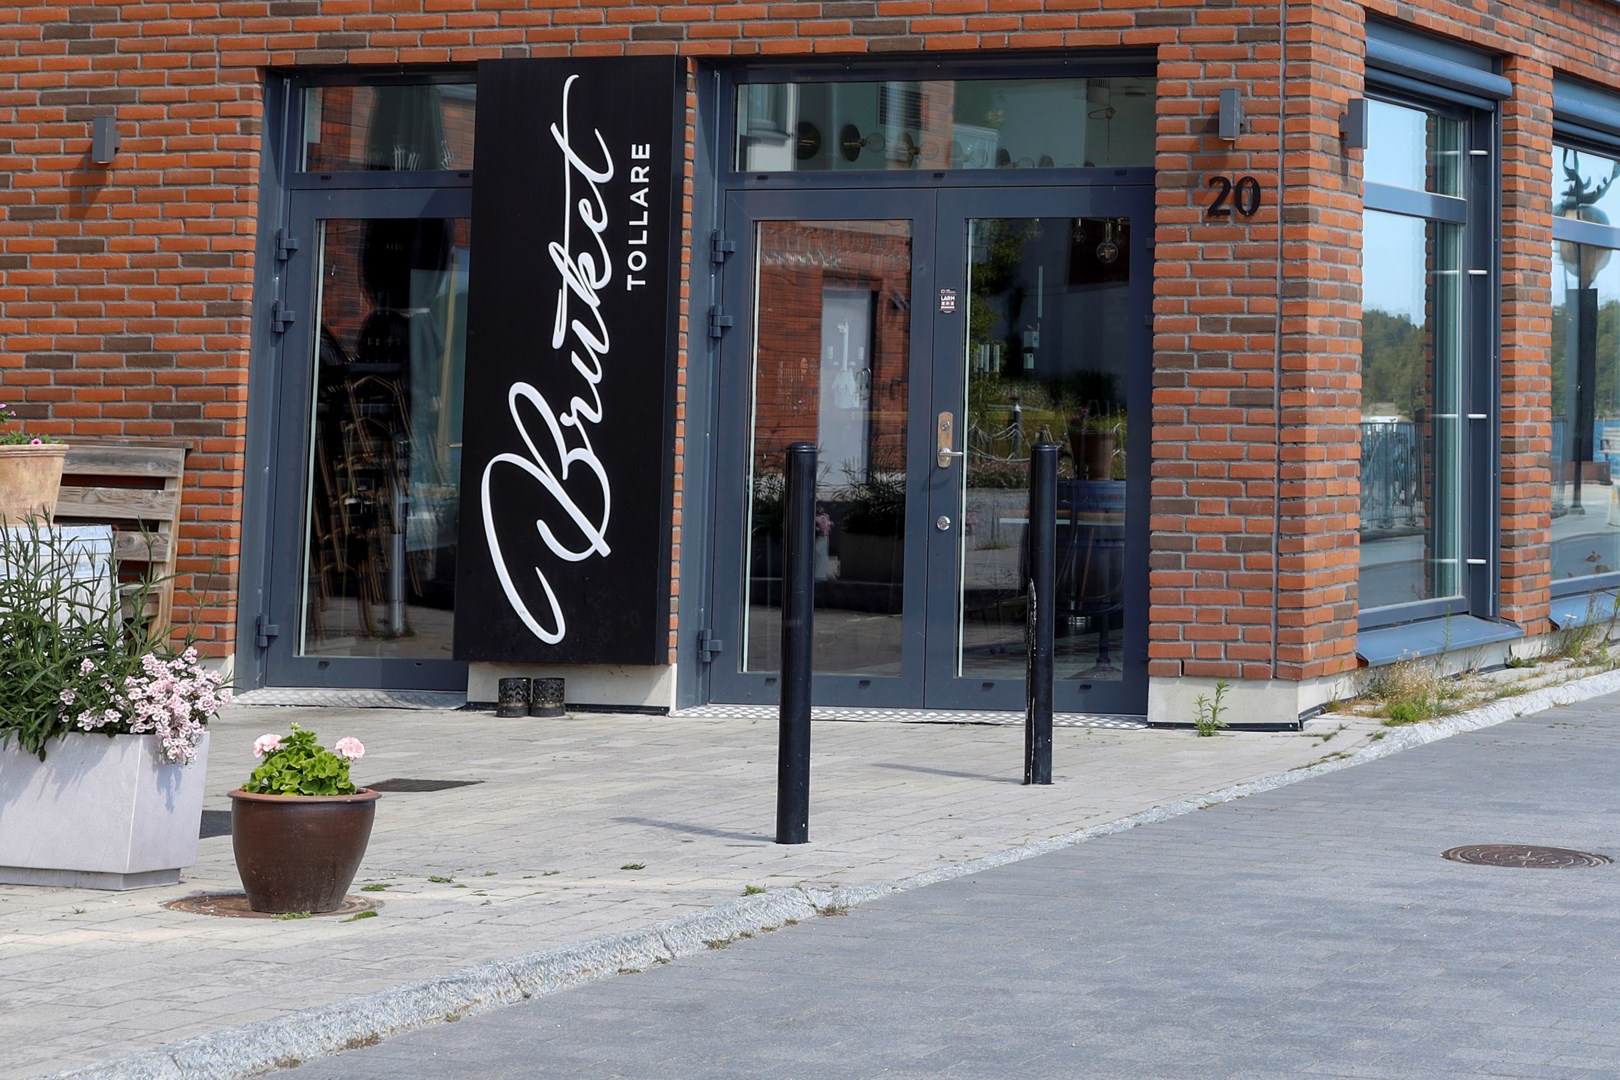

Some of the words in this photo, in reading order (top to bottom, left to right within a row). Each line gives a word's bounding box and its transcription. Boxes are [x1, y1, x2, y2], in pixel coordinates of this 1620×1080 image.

[626, 143, 651, 291] TOLLARE
[1207, 176, 1261, 217] 20
[481, 74, 614, 644] Bruket
